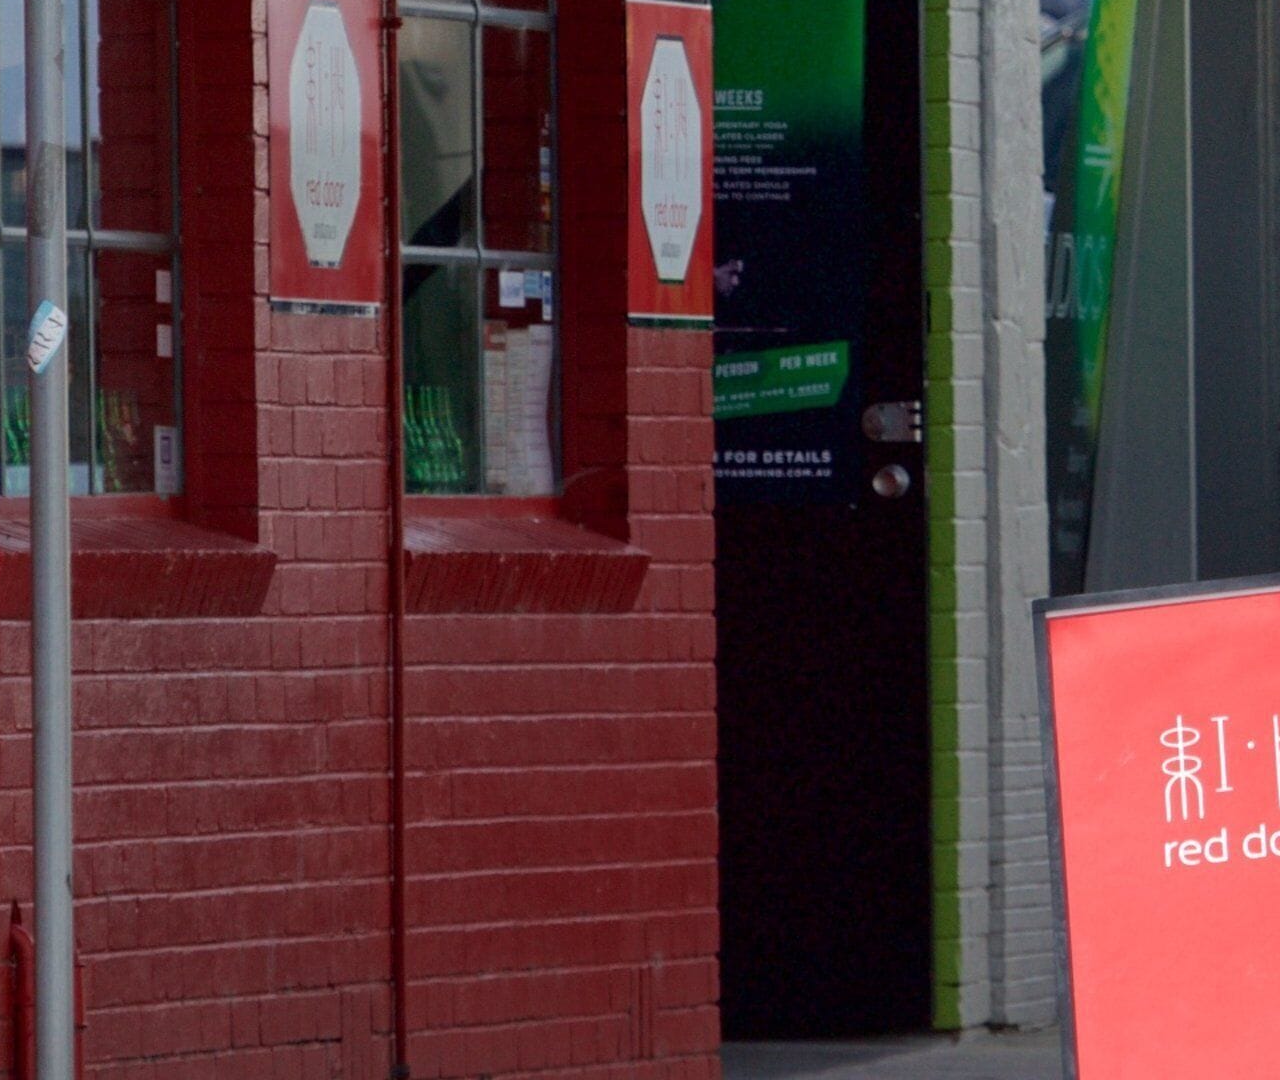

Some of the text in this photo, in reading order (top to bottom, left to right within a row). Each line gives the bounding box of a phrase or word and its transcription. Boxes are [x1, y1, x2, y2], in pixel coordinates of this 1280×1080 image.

[724, 450, 832, 464] FOR DETAILS
[1164, 827, 1229, 868] red
